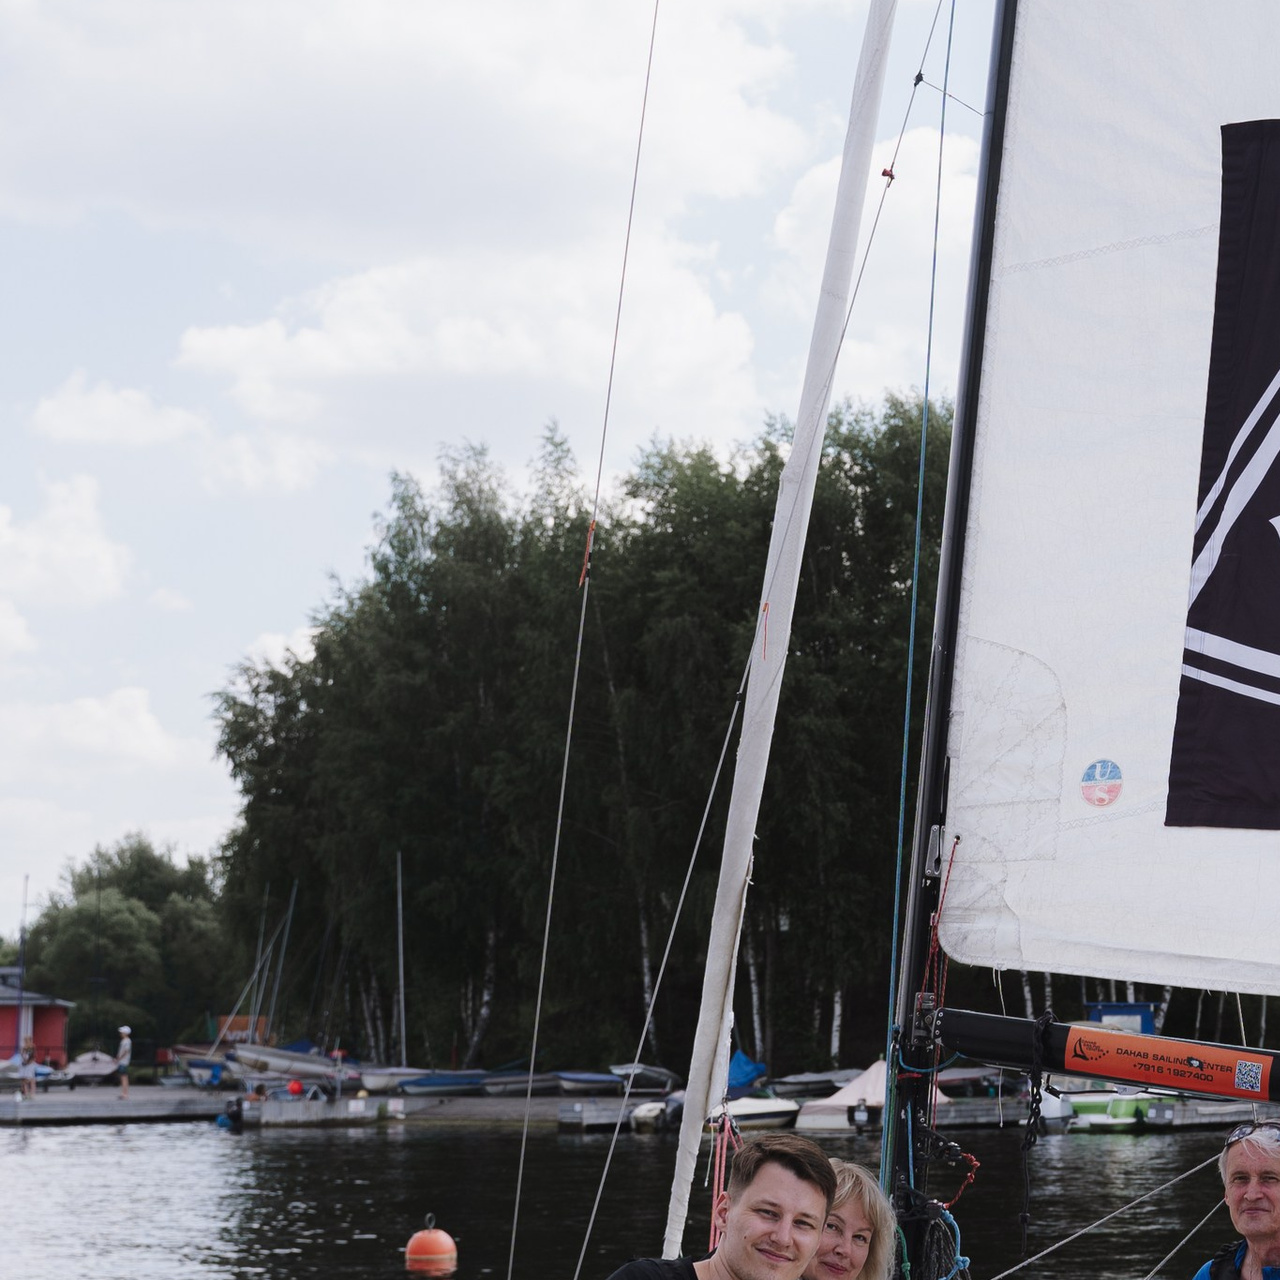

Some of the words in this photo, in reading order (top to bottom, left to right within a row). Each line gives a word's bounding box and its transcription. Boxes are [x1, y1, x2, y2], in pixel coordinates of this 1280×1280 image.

[1116, 1047, 1149, 1060] DAHAB
[1198, 1060, 1233, 1074] ENTER
[1166, 1067, 1214, 1082] 1927400
